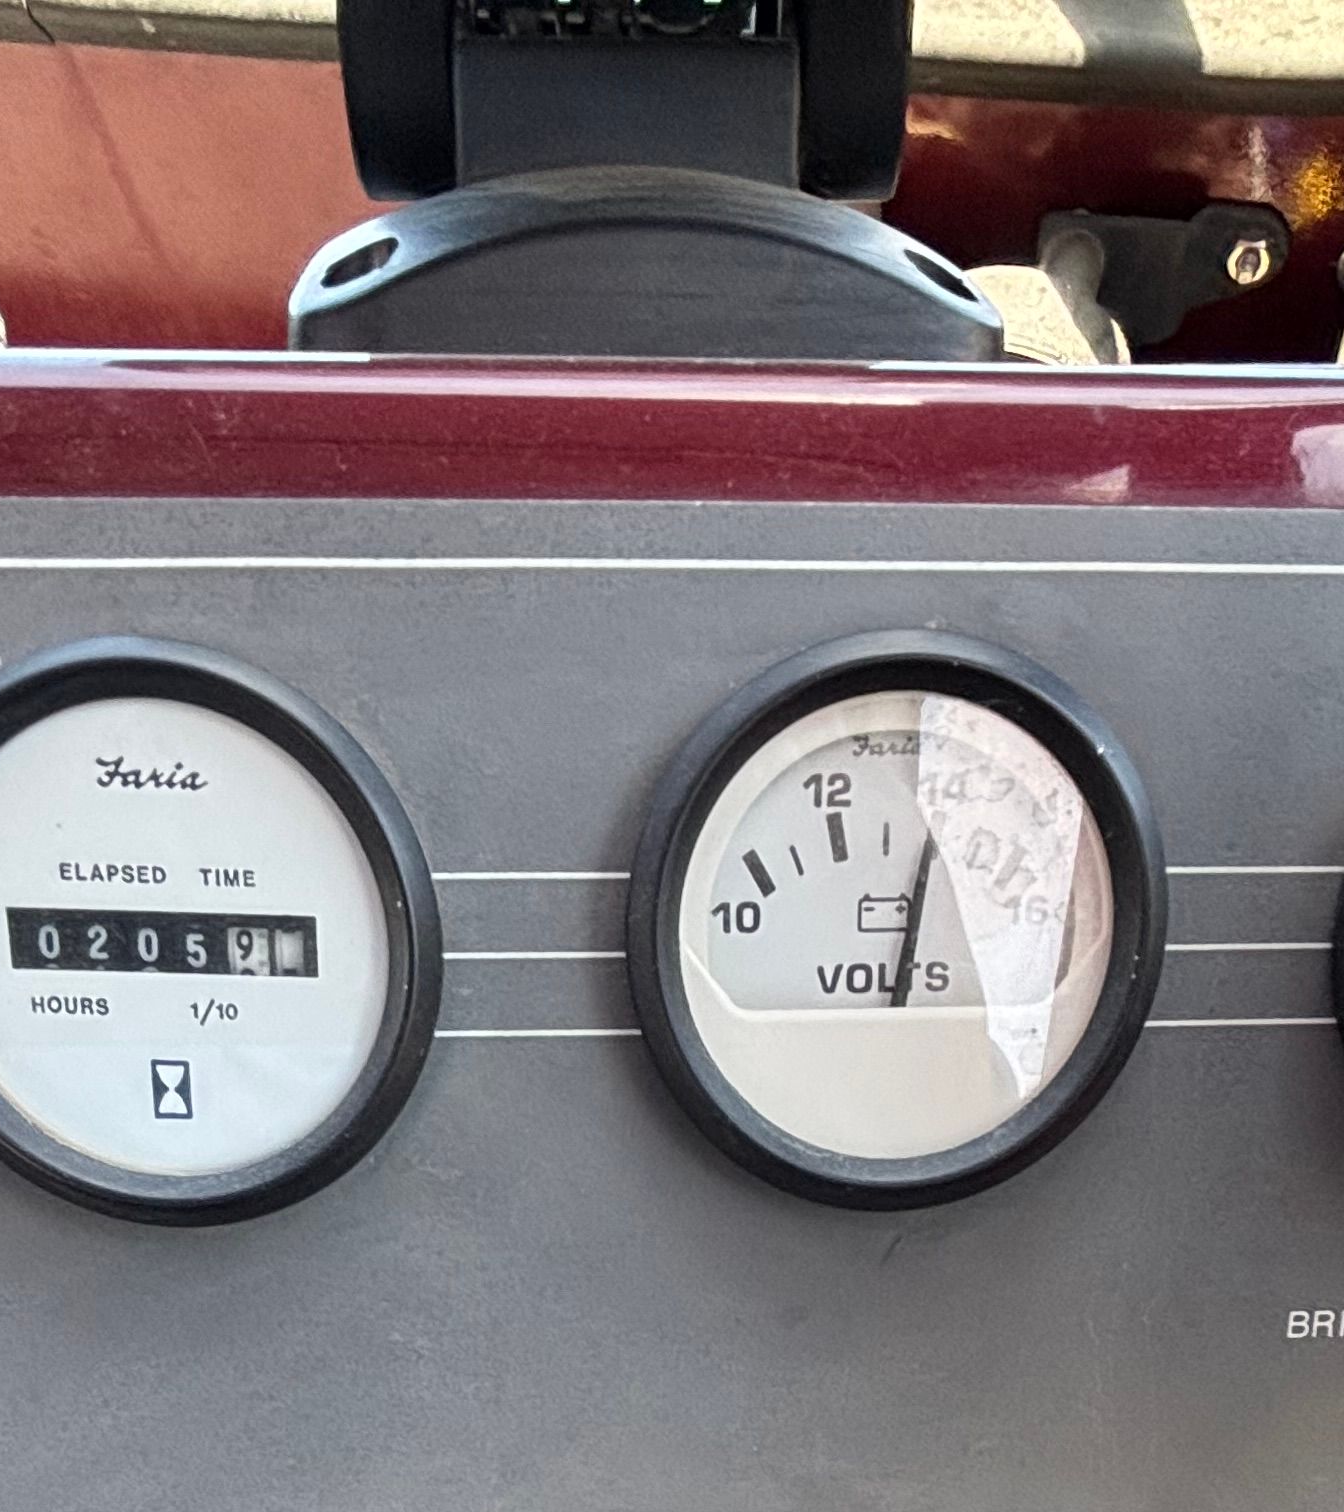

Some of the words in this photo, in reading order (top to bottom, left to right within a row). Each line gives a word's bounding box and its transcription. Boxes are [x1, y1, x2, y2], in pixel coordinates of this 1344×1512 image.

[95, 755, 208, 790] Faria
[803, 772, 852, 809] 12
[58, 862, 168, 885] ELAPSED
[199, 868, 257, 889] TIME
[711, 902, 762, 934] 10
[30, 996, 110, 1016] HOURS
[190, 999, 239, 1026] 1/10
